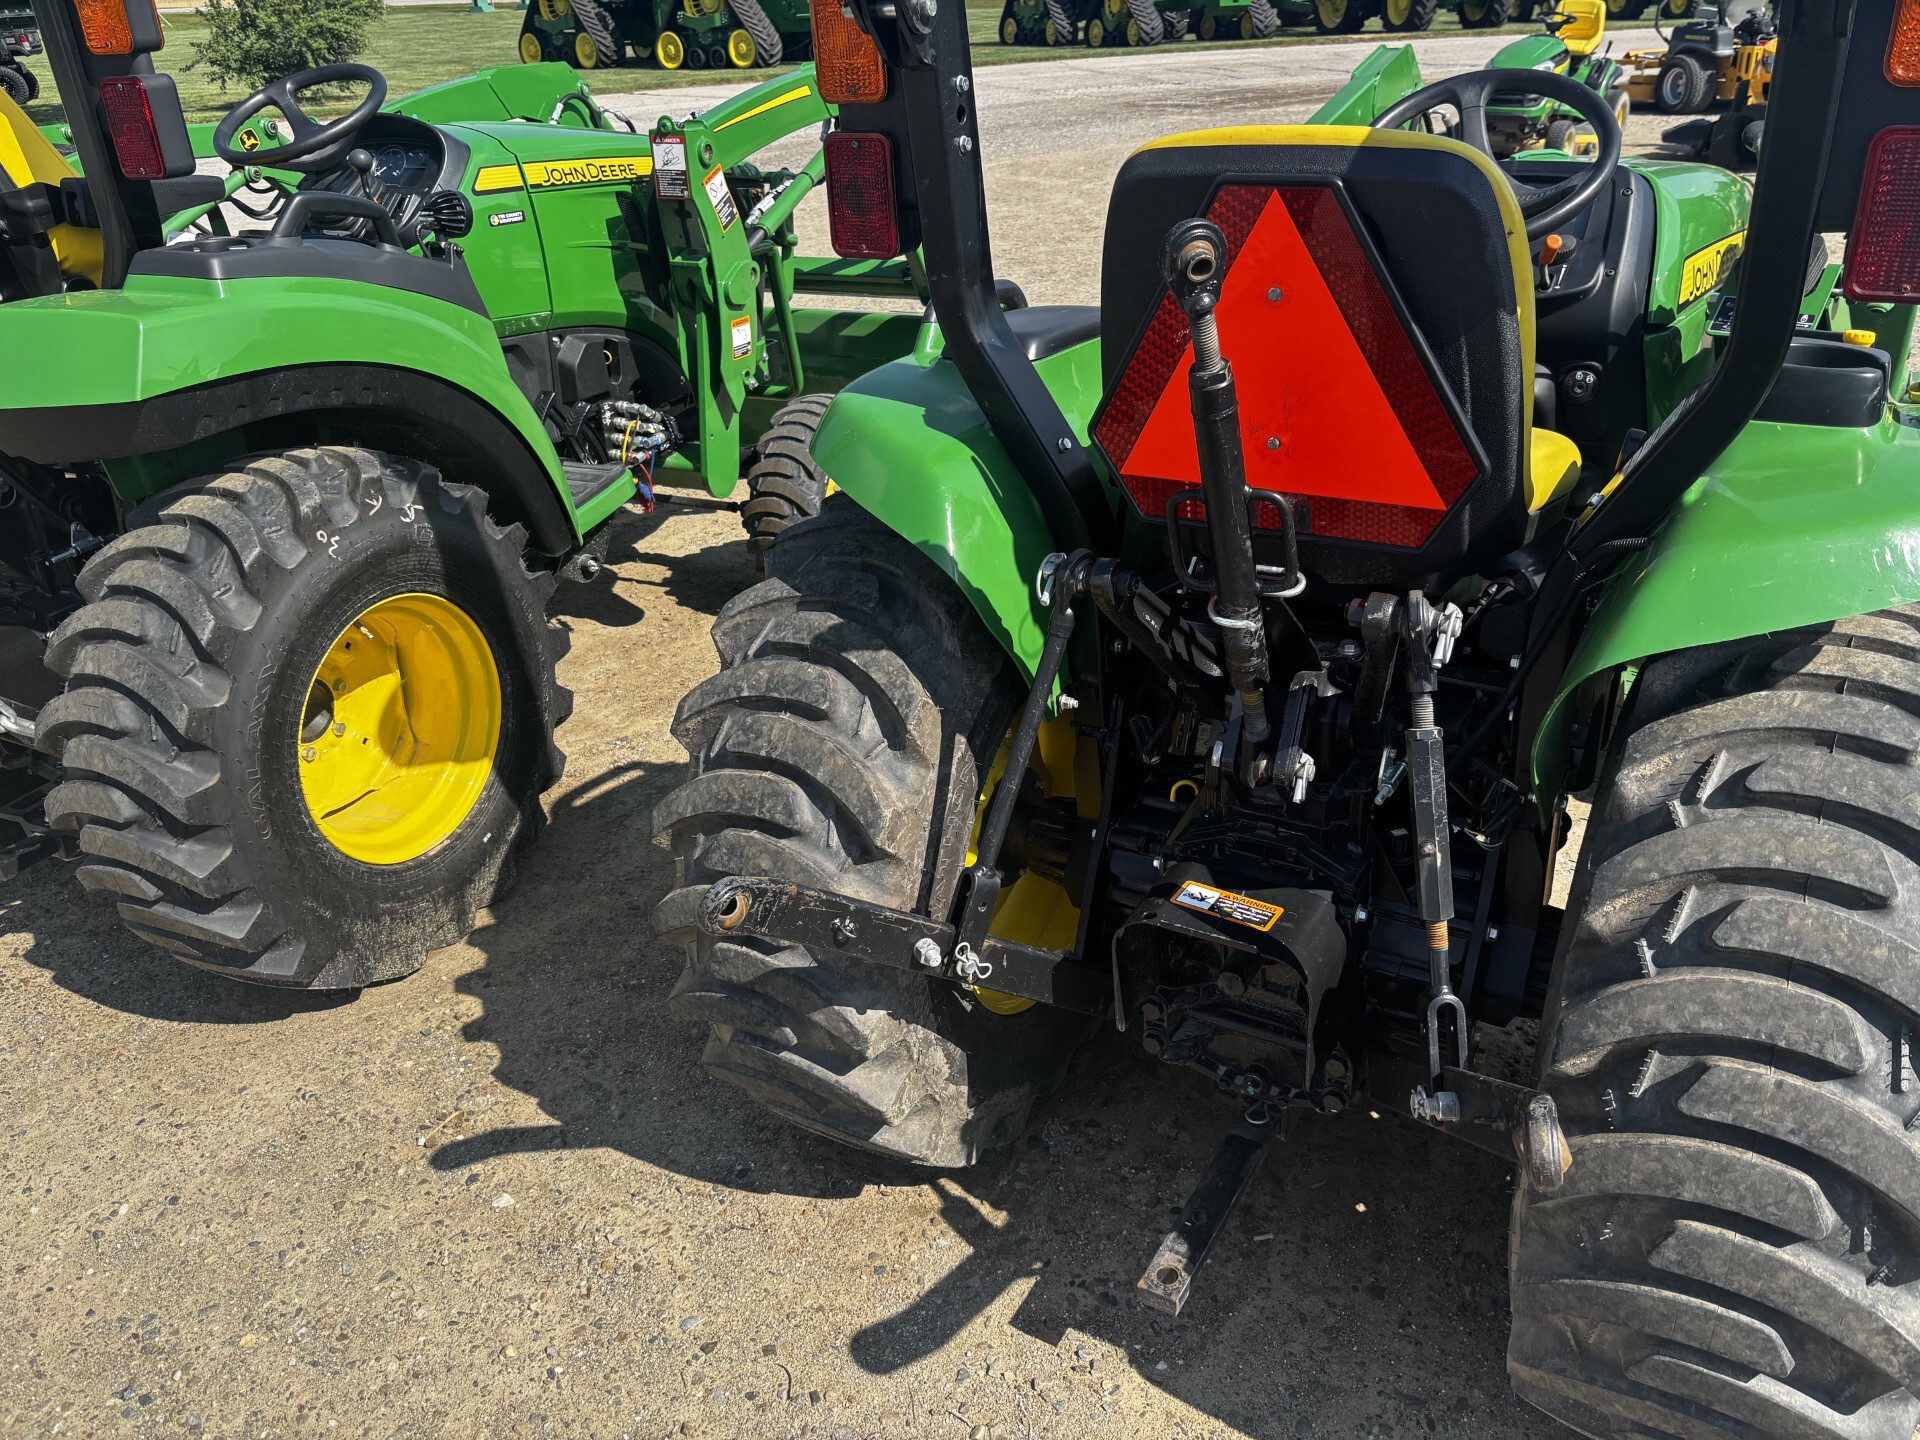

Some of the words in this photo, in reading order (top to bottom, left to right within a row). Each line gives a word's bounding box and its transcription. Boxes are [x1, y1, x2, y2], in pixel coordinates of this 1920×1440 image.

[543, 166, 586, 183] JOHN
[586, 163, 638, 180] DEERE
[1689, 259, 1714, 297] JOHN
[246, 650, 279, 841] GALAXY
[1232, 893, 1277, 913] WARNING
